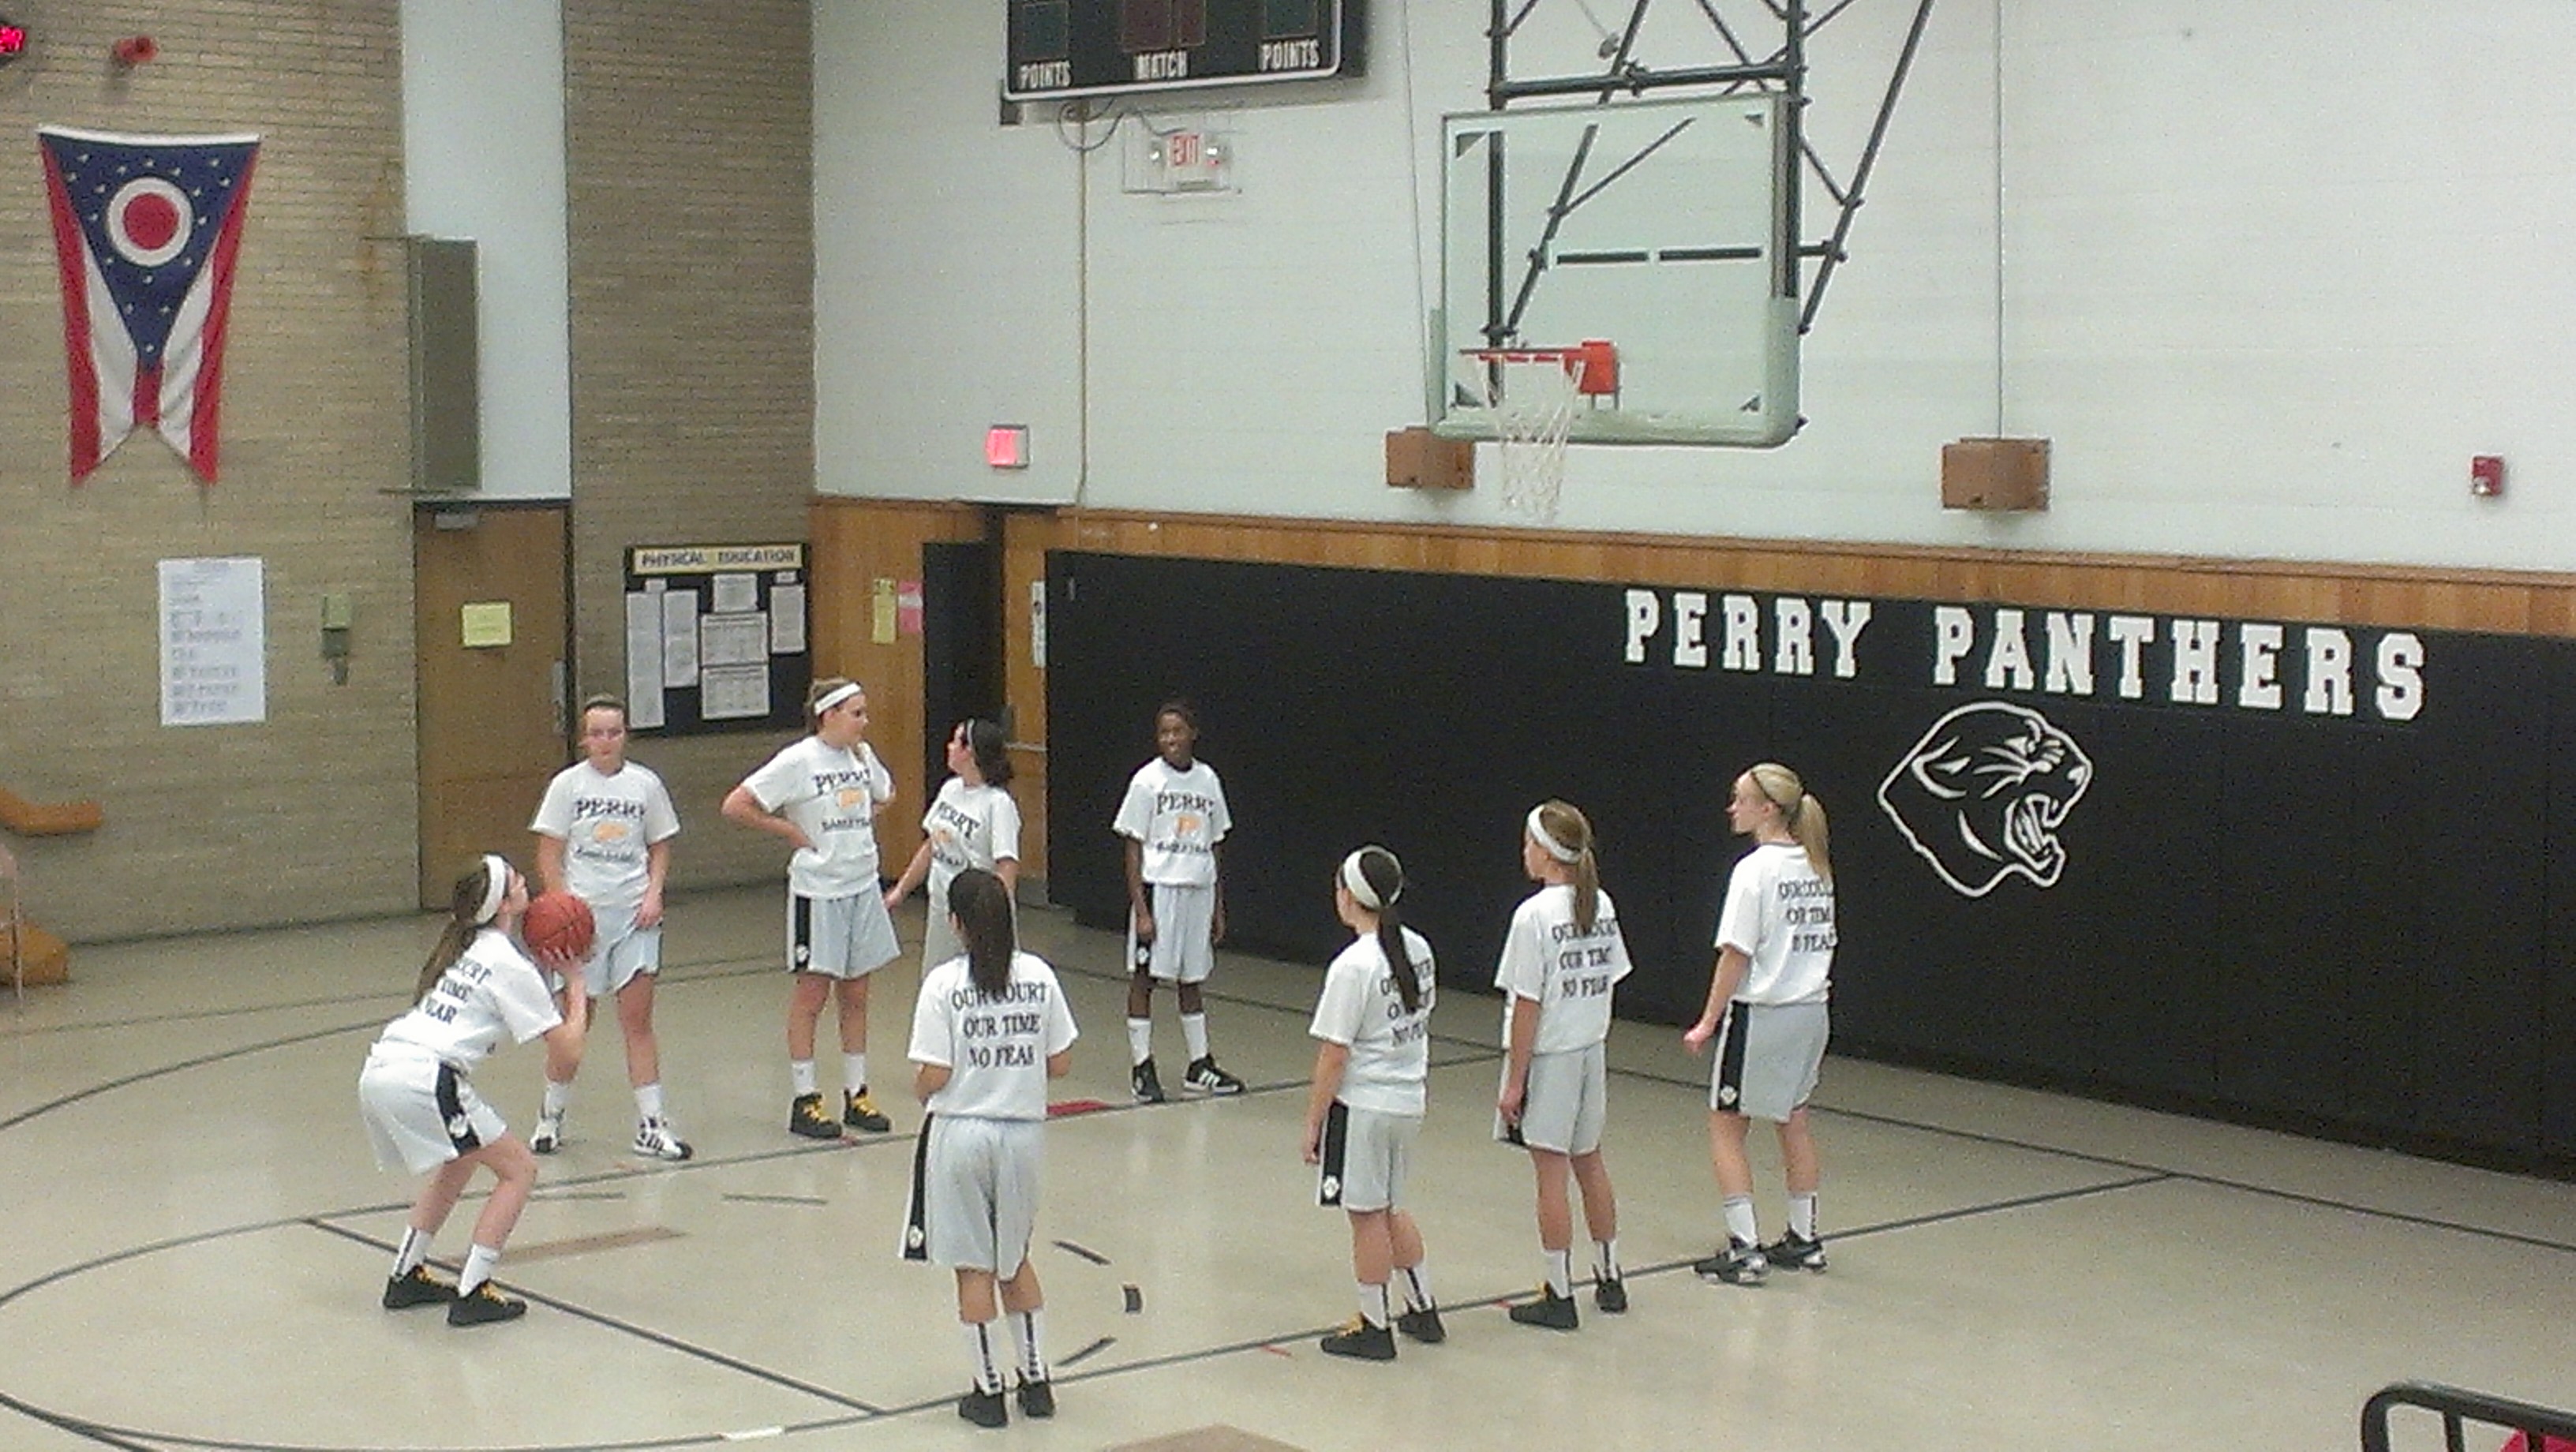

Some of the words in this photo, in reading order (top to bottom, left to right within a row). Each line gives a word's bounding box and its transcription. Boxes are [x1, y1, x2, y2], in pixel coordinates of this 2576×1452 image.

[1135, 51, 1188, 79] MATCH
[1261, 39, 1320, 70] POINTS
[1017, 59, 1072, 89] POINTS
[642, 551, 706, 567] PHYSICAL
[717, 548, 796, 563] EDUCATION
[1624, 589, 1872, 679] PERRY
[1934, 605, 2425, 720] PANTHERS
[952, 986, 988, 1011] OUR
[963, 1016, 998, 1038] OUR
[1002, 1013, 1041, 1035] TIME
[968, 1047, 991, 1068] NO
